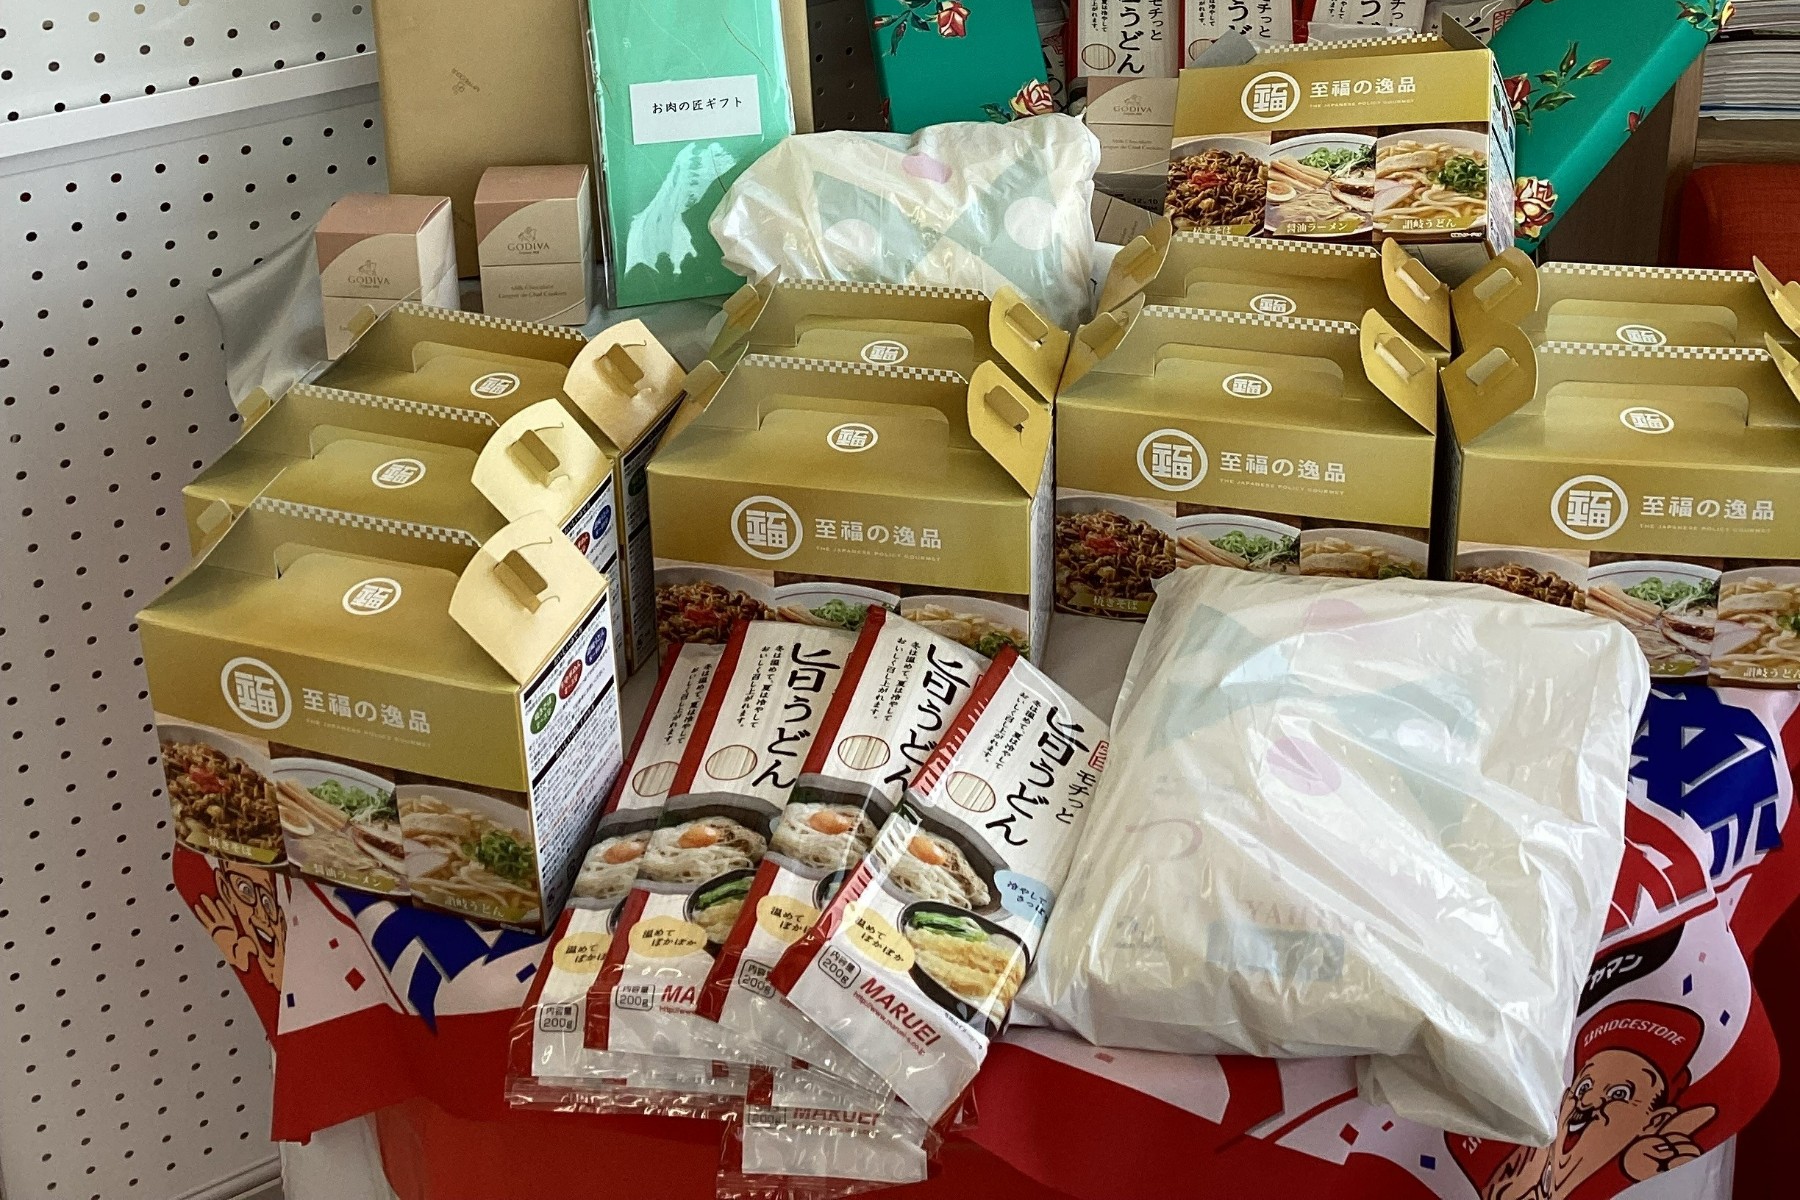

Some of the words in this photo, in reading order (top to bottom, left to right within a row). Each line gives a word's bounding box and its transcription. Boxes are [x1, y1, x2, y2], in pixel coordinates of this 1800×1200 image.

[1309, 76, 1417, 99] 至福の逸品
[651, 95, 744, 115] お肉の匠ギフト
[1113, 105, 1153, 114] GODIVA
[1285, 221, 1349, 233] 醤油ラーメン
[507, 242, 551, 252] GODIVA
[347, 275, 390, 286] GODIVA
[1219, 451, 1346, 484] 至福の逸品
[1640, 495, 1775, 521] 至福の逸品
[814, 516, 943, 551] 至福の逸品
[1093, 595, 1139, 611] 焼きそば
[301, 686, 432, 735] 至福の逸品
[752, 642, 841, 789] 旨うどん
[985, 705, 1090, 846] 旨うどん
[1055, 769, 1097, 825] モチっと
[822, 958, 850, 985] 200g
[829, 949, 857, 975] 内容量
[621, 985, 650, 995] 内容量
[742, 976, 773, 998] 200g
[545, 1007, 573, 1017] 内容量
[619, 994, 651, 1008] 200g
[859, 977, 942, 1047] MARUEI
[542, 1017, 574, 1030] 200g
[1583, 1017, 1687, 1048] BRIDGESTONE
